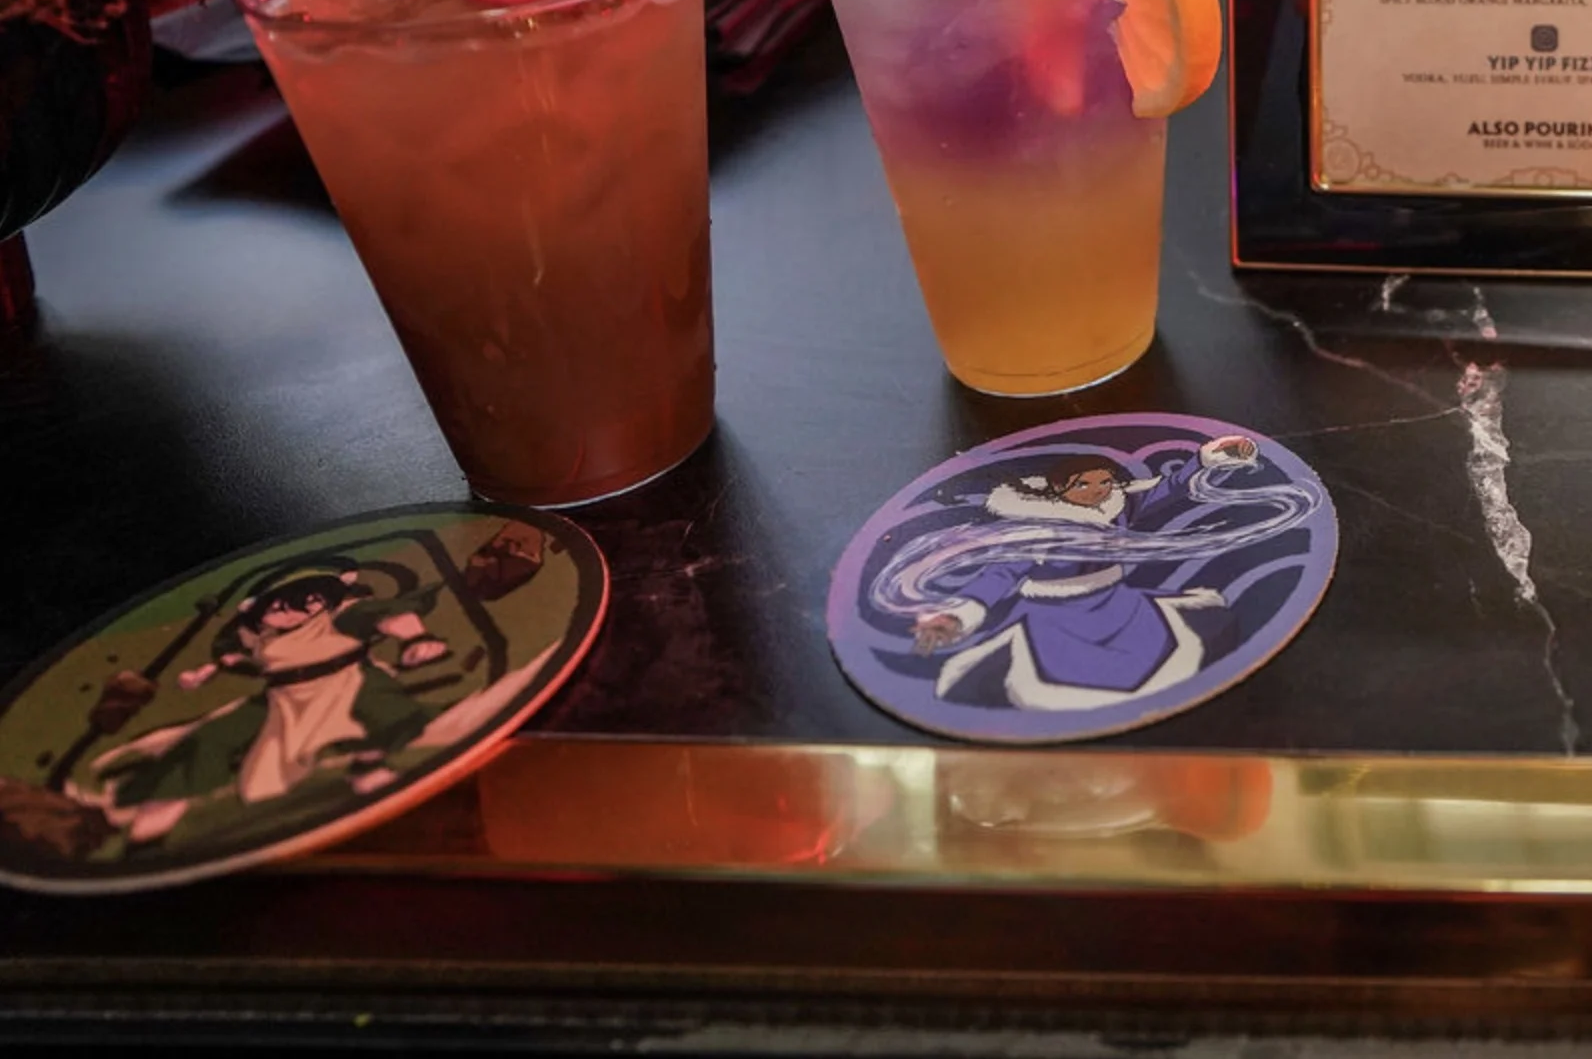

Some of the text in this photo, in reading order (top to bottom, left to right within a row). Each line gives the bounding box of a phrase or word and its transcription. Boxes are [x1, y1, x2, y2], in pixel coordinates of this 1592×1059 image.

[1488, 56, 1519, 71] YIP
[1525, 56, 1557, 71] YIP
[1468, 121, 1519, 136] ALSO
